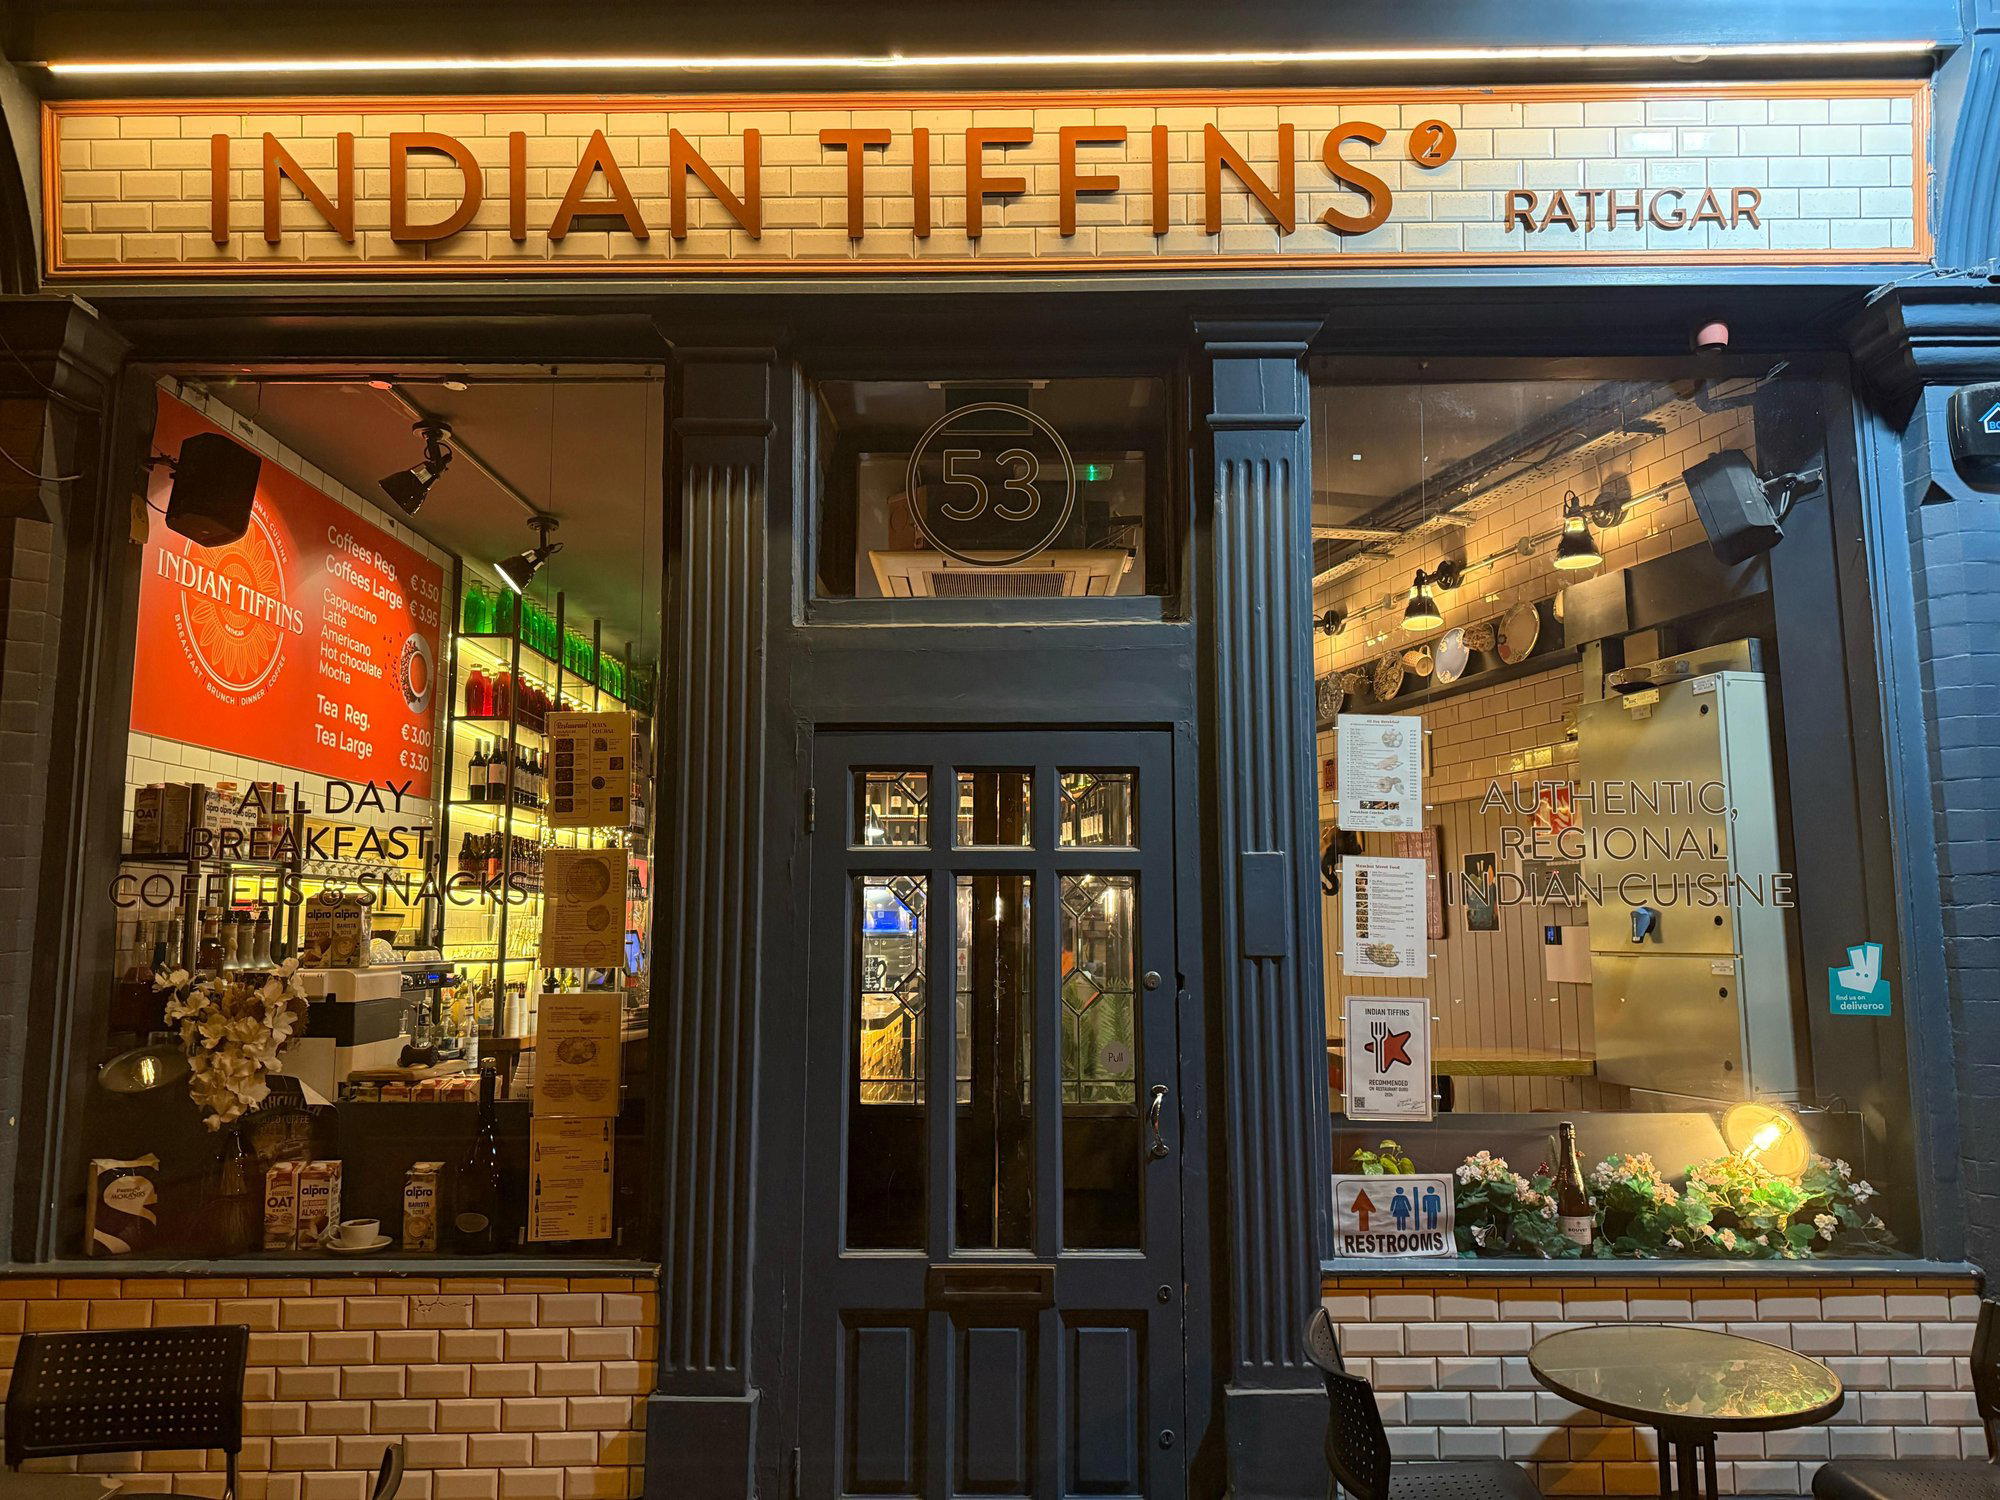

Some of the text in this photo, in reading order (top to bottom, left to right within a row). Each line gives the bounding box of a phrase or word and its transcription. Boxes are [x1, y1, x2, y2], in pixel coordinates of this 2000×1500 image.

[211, 121, 1443, 243] INDIAN TIFFINS 2
[1505, 186, 1763, 232] RATHGAR
[941, 449, 1040, 521] 53
[270, 523, 288, 564] CUISINE
[328, 525, 372, 565] Coffees
[374, 551, 398, 582] Reg.
[157, 547, 303, 635] INDIAN TIFFINS
[326, 554, 371, 593] Coffees
[373, 578, 403, 610] Large
[322, 605, 347, 628] Latte
[323, 587, 377, 624] Cappuccino
[321, 624, 371, 657] Americano
[175, 613, 287, 706] BREAKFAST BRUNCH DINNER COFFEE
[319, 659, 351, 684] Mocha
[320, 641, 383, 679] Hot chocolate
[316, 693, 339, 719] Tea
[345, 703, 371, 732] Reg.
[411, 726, 431, 748] 3.00
[314, 723, 336, 748] Tea
[340, 731, 373, 760] Large
[410, 752, 430, 772] 3.30
[135, 809, 158, 819] OAT
[238, 780, 413, 814] ALL DAY
[1479, 780, 1739, 822] AUTHENTIC,
[190, 826, 441, 867] BREAKFAST,
[1499, 826, 1729, 860] REGIONAL
[108, 873, 304, 908] COFFEES
[319, 877, 348, 906] &
[357, 872, 528, 907] SNACKS
[1446, 871, 1603, 908] INDIAN
[1618, 872, 1796, 908] CUISINE
[307, 909, 331, 920] alpro
[335, 909, 359, 920] alpro
[1365, 1008, 1410, 1016] INDIAN TIFFINS
[1840, 1001, 1885, 1010] deliveroo
[1368, 1079, 1409, 1087] RECOMMENDED
[267, 1197, 294, 1208] OAT
[301, 1185, 329, 1197] alpro
[405, 1187, 433, 1199] alpro
[1344, 1232, 1444, 1255] RESTROOMS
